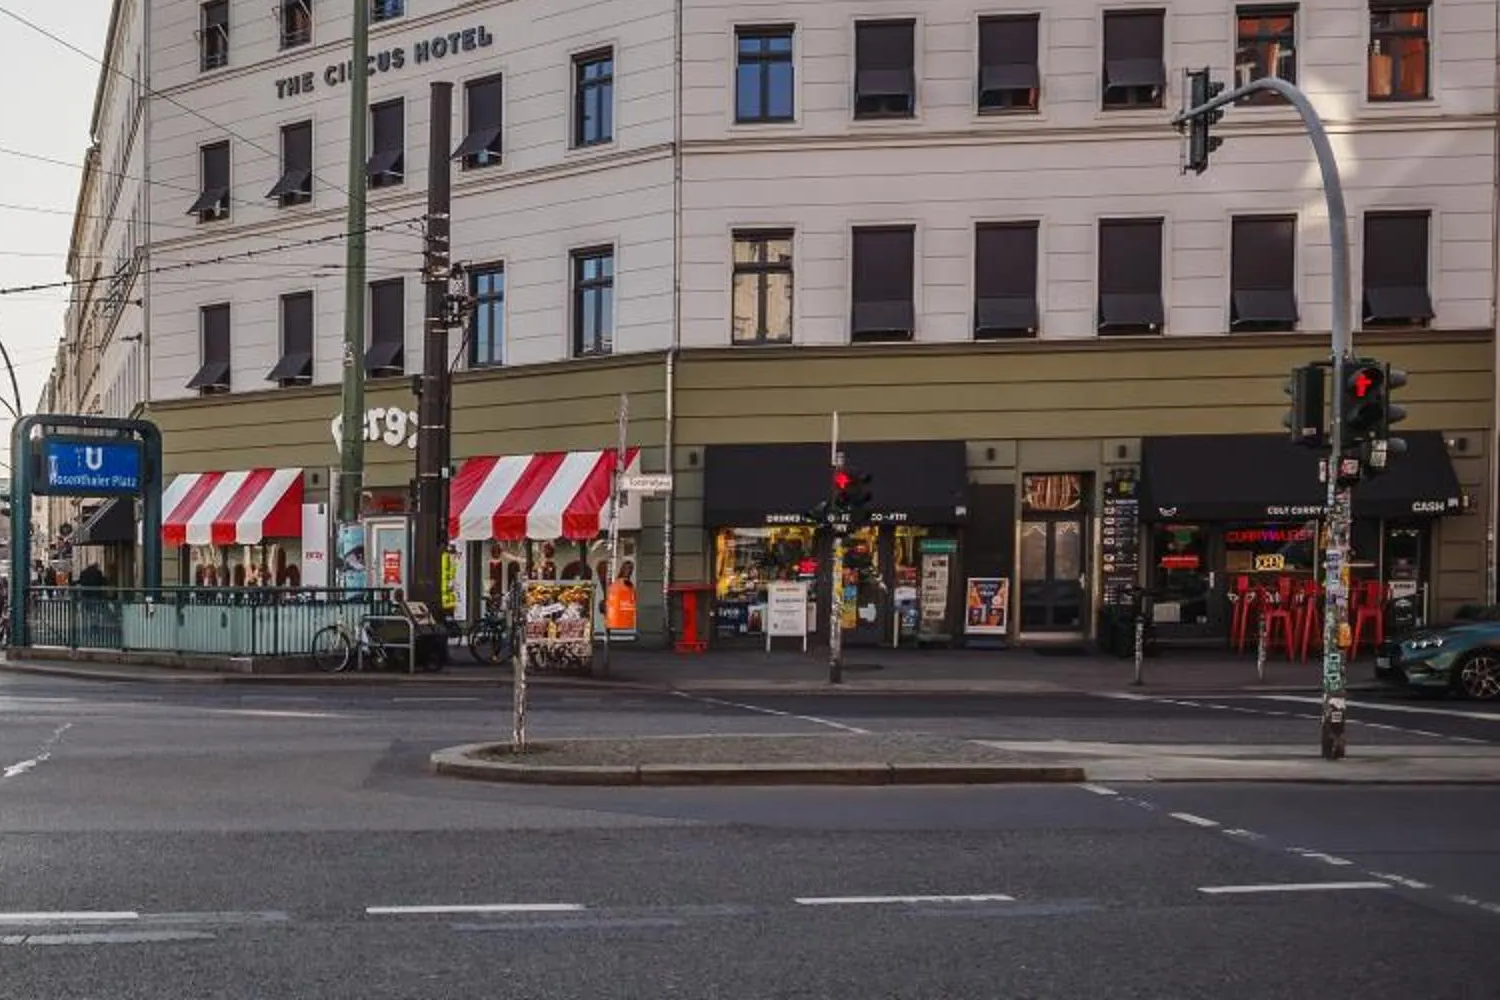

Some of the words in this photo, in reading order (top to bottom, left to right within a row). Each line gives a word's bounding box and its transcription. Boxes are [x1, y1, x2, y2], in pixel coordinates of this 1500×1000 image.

[275, 71, 315, 100] THE
[413, 25, 493, 64] HOTEL
[85, 446, 103, 470] U
[111, 474, 137, 488] Platz
[1412, 502, 1445, 513] CASH
